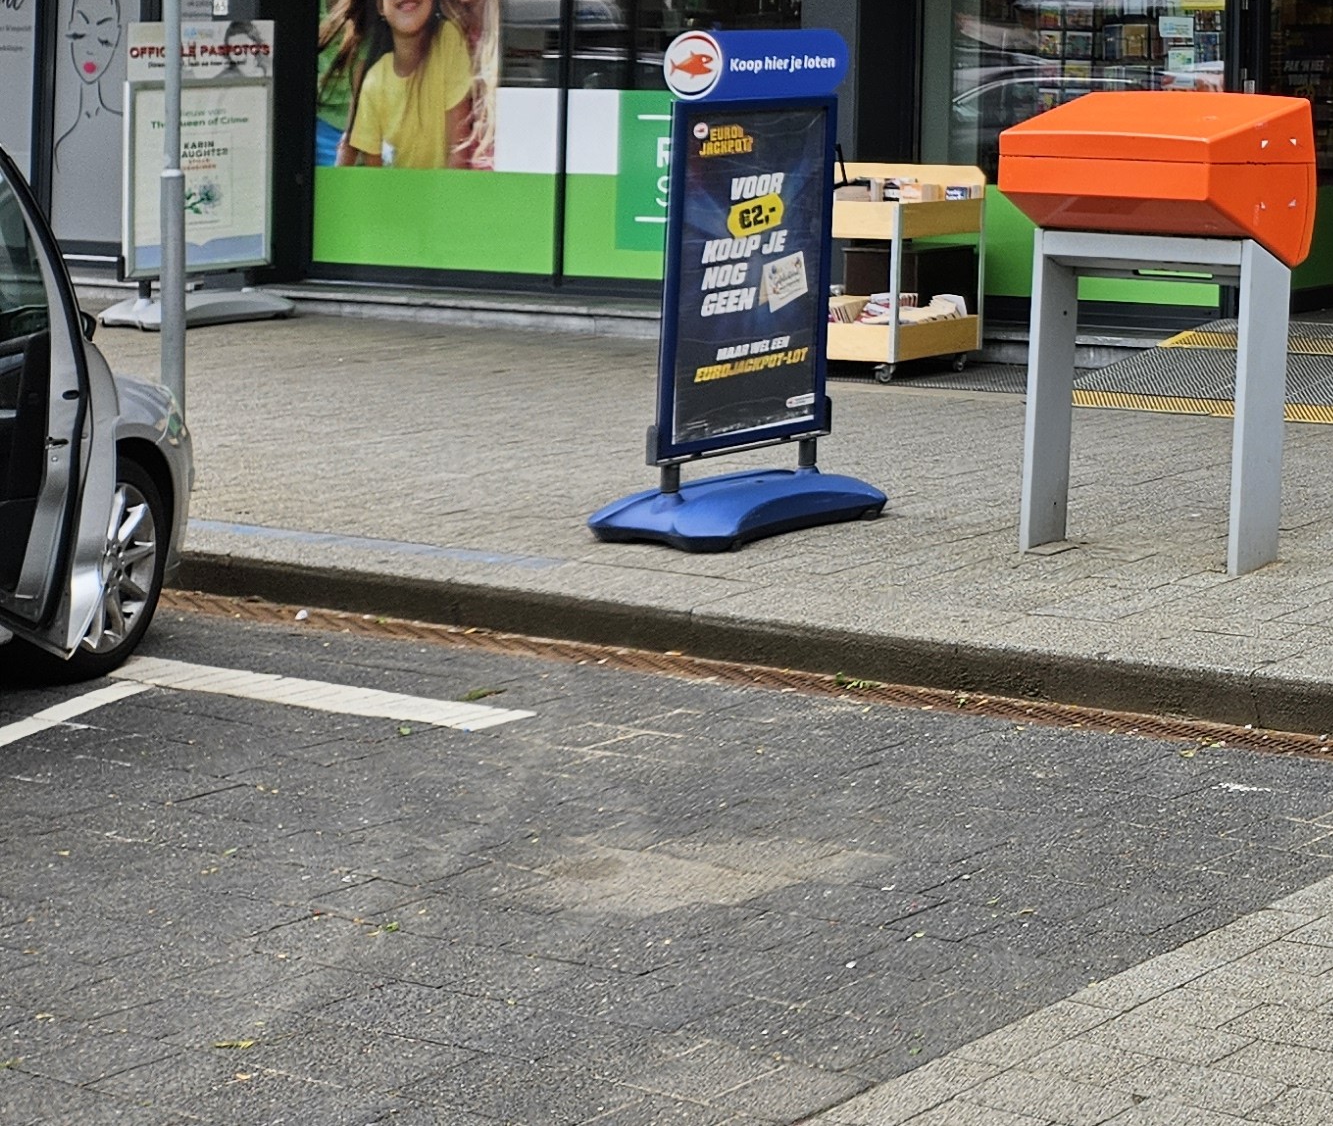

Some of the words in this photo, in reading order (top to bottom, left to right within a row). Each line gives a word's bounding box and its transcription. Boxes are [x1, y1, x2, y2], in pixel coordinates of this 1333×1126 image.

[730, 57, 763, 74] Koop
[764, 55, 789, 70] hier
[789, 56, 803, 73] je
[803, 55, 836, 69] loten
[181, 119, 206, 128] ueen
[730, 172, 785, 200] VOOR
[701, 235, 761, 264] KOOP
[761, 229, 788, 254] JE
[701, 262, 748, 291] NOG
[700, 286, 757, 318] GEEN
[716, 344, 750, 362] MAAR
[771, 335, 791, 350] EEN
